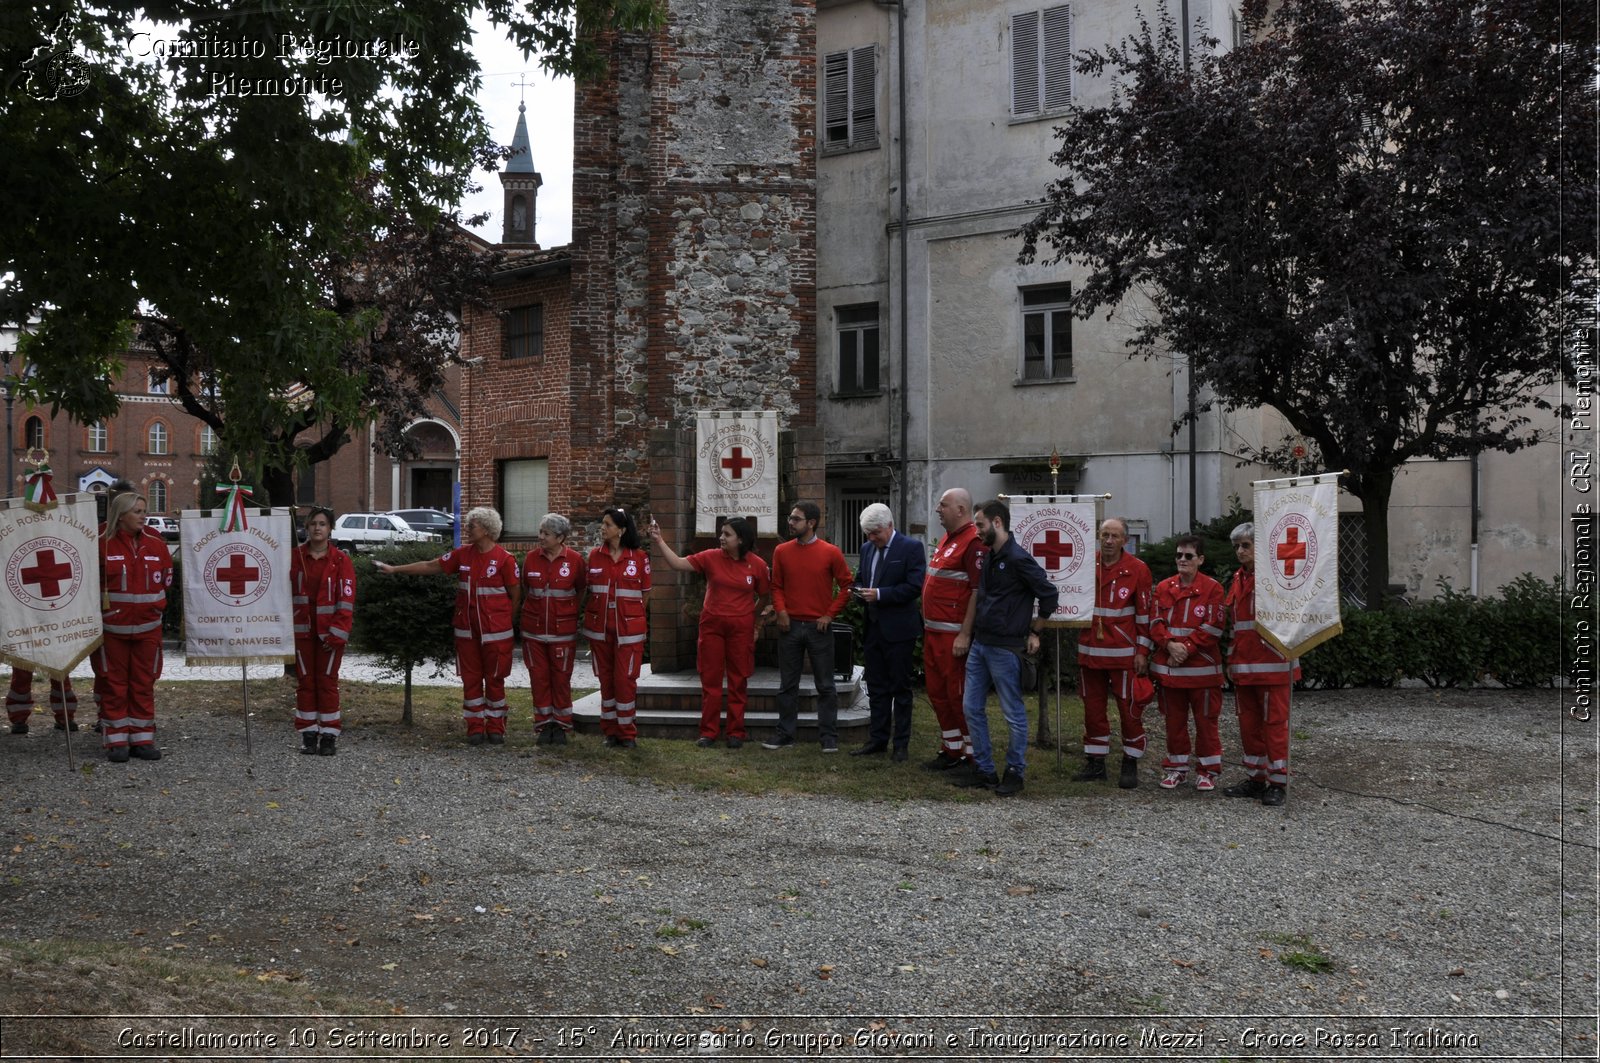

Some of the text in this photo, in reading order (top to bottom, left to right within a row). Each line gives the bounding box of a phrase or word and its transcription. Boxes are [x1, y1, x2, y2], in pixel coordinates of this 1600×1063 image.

[719, 424, 746, 436] ROSSA
[748, 426, 775, 458] ITALIANA
[1013, 470, 1042, 482] AVIS
[702, 506, 772, 514] CASTELLAMONTE
[16, 512, 54, 529] ROSSA
[58, 514, 97, 542] ITALIANA
[1014, 507, 1091, 535] CROCE ROSSA ITALIANA
[1033, 524, 1041, 533] DI
[1040, 520, 1068, 531] GINEVRA
[193, 530, 218, 553] CROCE
[249, 527, 280, 552] ITALIANA
[1074, 534, 1084, 559] AGOSTO
[7, 538, 82, 604] CONVENZIONE DI GINEVRA 22 AGOSTO 1864
[204, 544, 270, 598] CONVENZIONE DI GINEVRA 22 AGOSTO 1864
[1068, 556, 1082, 574] 1864
[1057, 585, 1083, 594] LOCALE
[1315, 577, 1326, 590] DI
[197, 615, 281, 624] COMITATO LOCALE
[1257, 610, 1274, 621] SAN
[7, 616, 94, 639] COMITATO LOCALE
[1, 627, 100, 653] SETTIMO TORINESE
[198, 637, 281, 647] PONT CANAVESE
